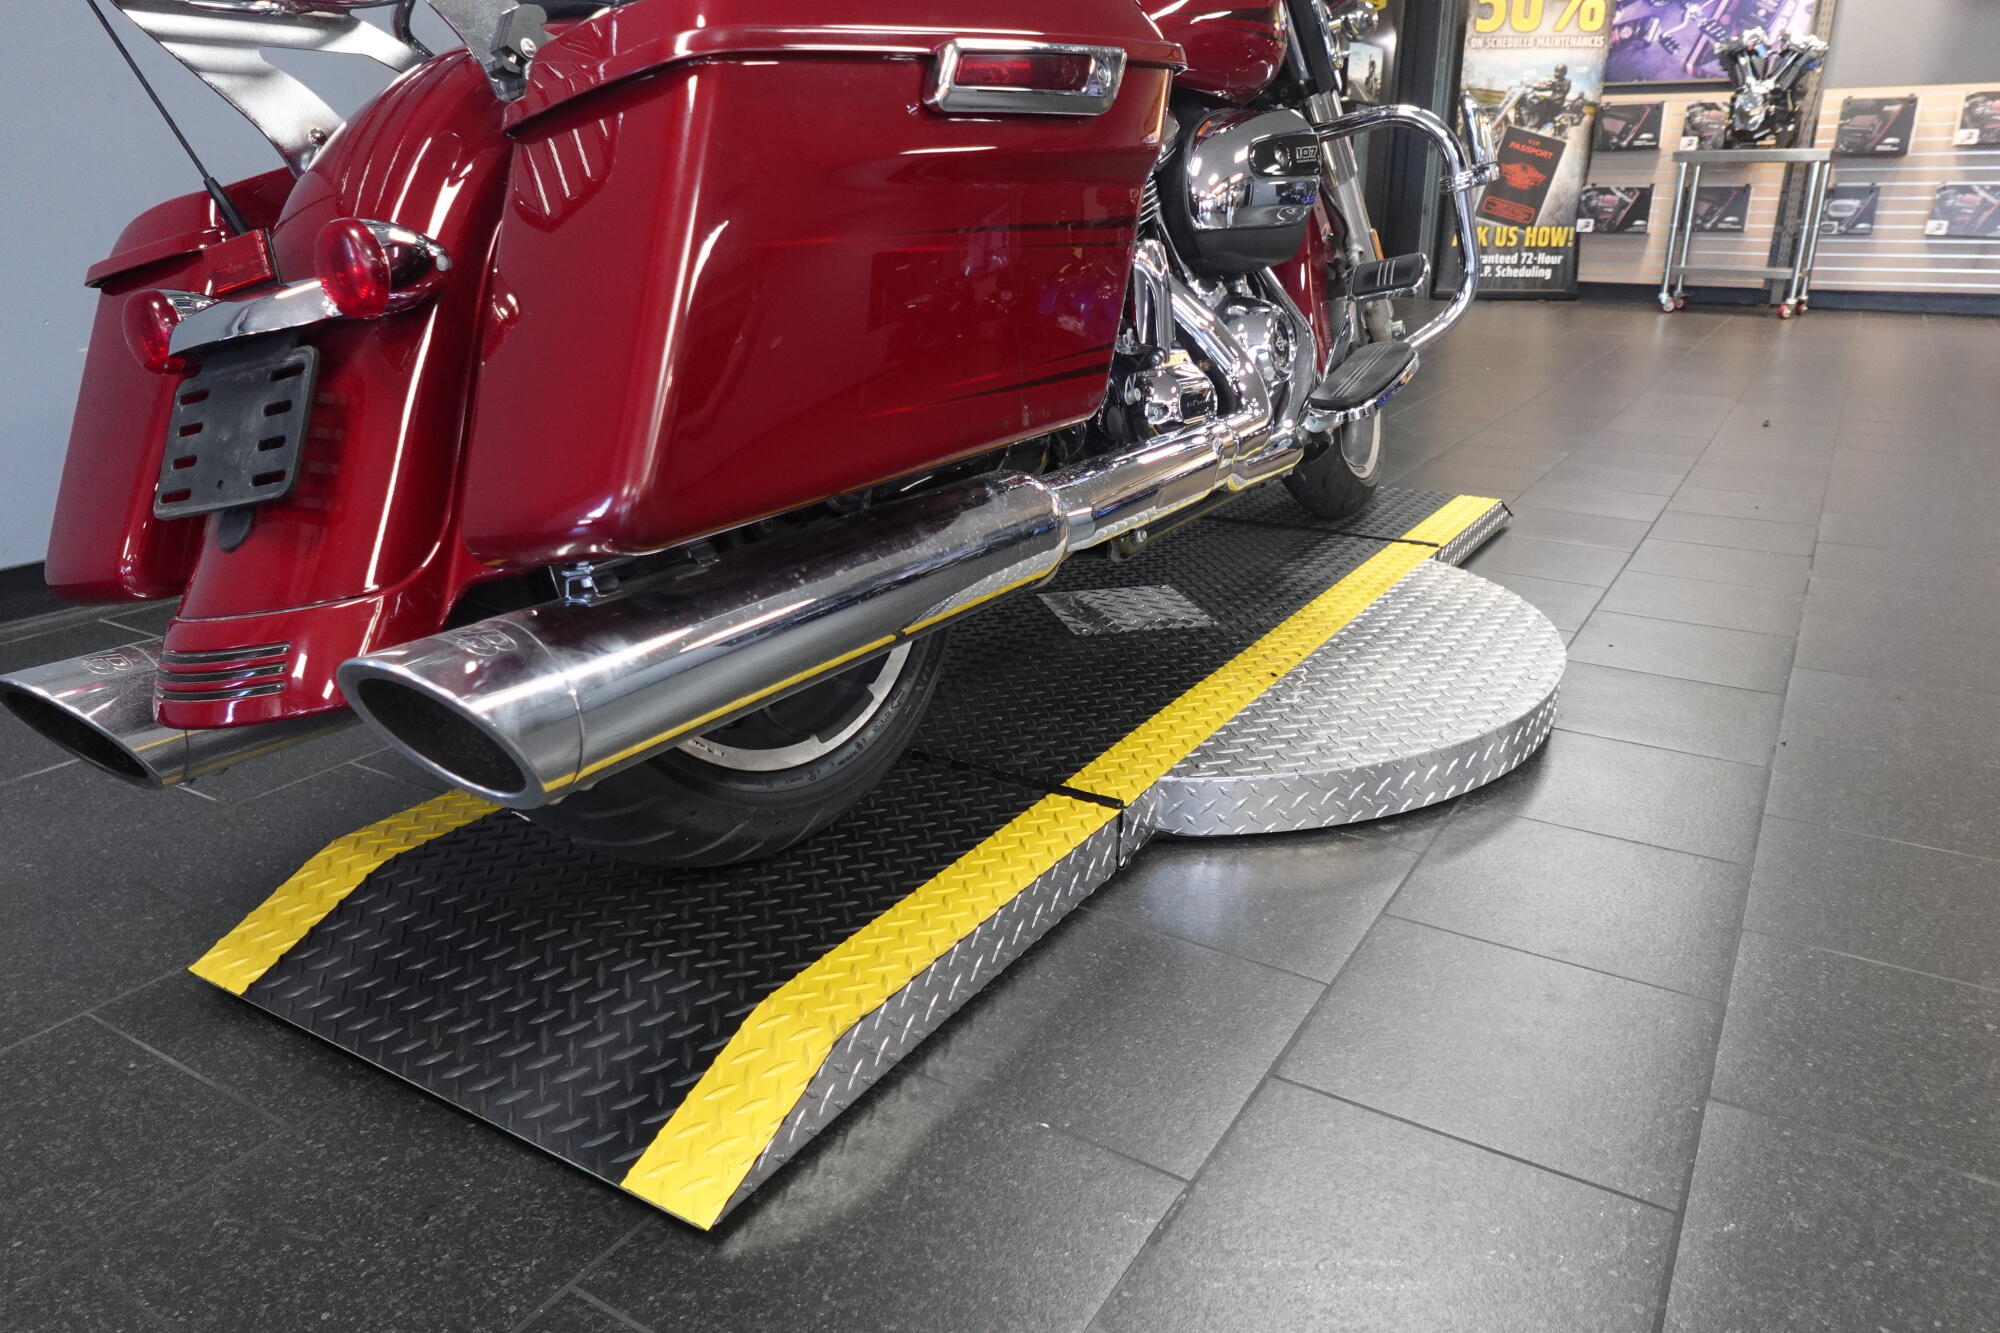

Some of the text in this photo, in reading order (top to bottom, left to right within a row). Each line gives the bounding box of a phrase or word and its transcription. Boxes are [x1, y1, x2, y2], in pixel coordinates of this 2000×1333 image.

[1470, 35, 1605, 48] ON SCHEDULED MAINTENANCES
[1296, 145, 1318, 160] 107
[1508, 141, 1553, 159] PASSPORT
[1494, 226, 1519, 247] US
[1524, 226, 1575, 247] HOW!
[1520, 252, 1563, 265] 72-Hour
[1495, 265, 1552, 280] Scheduling
